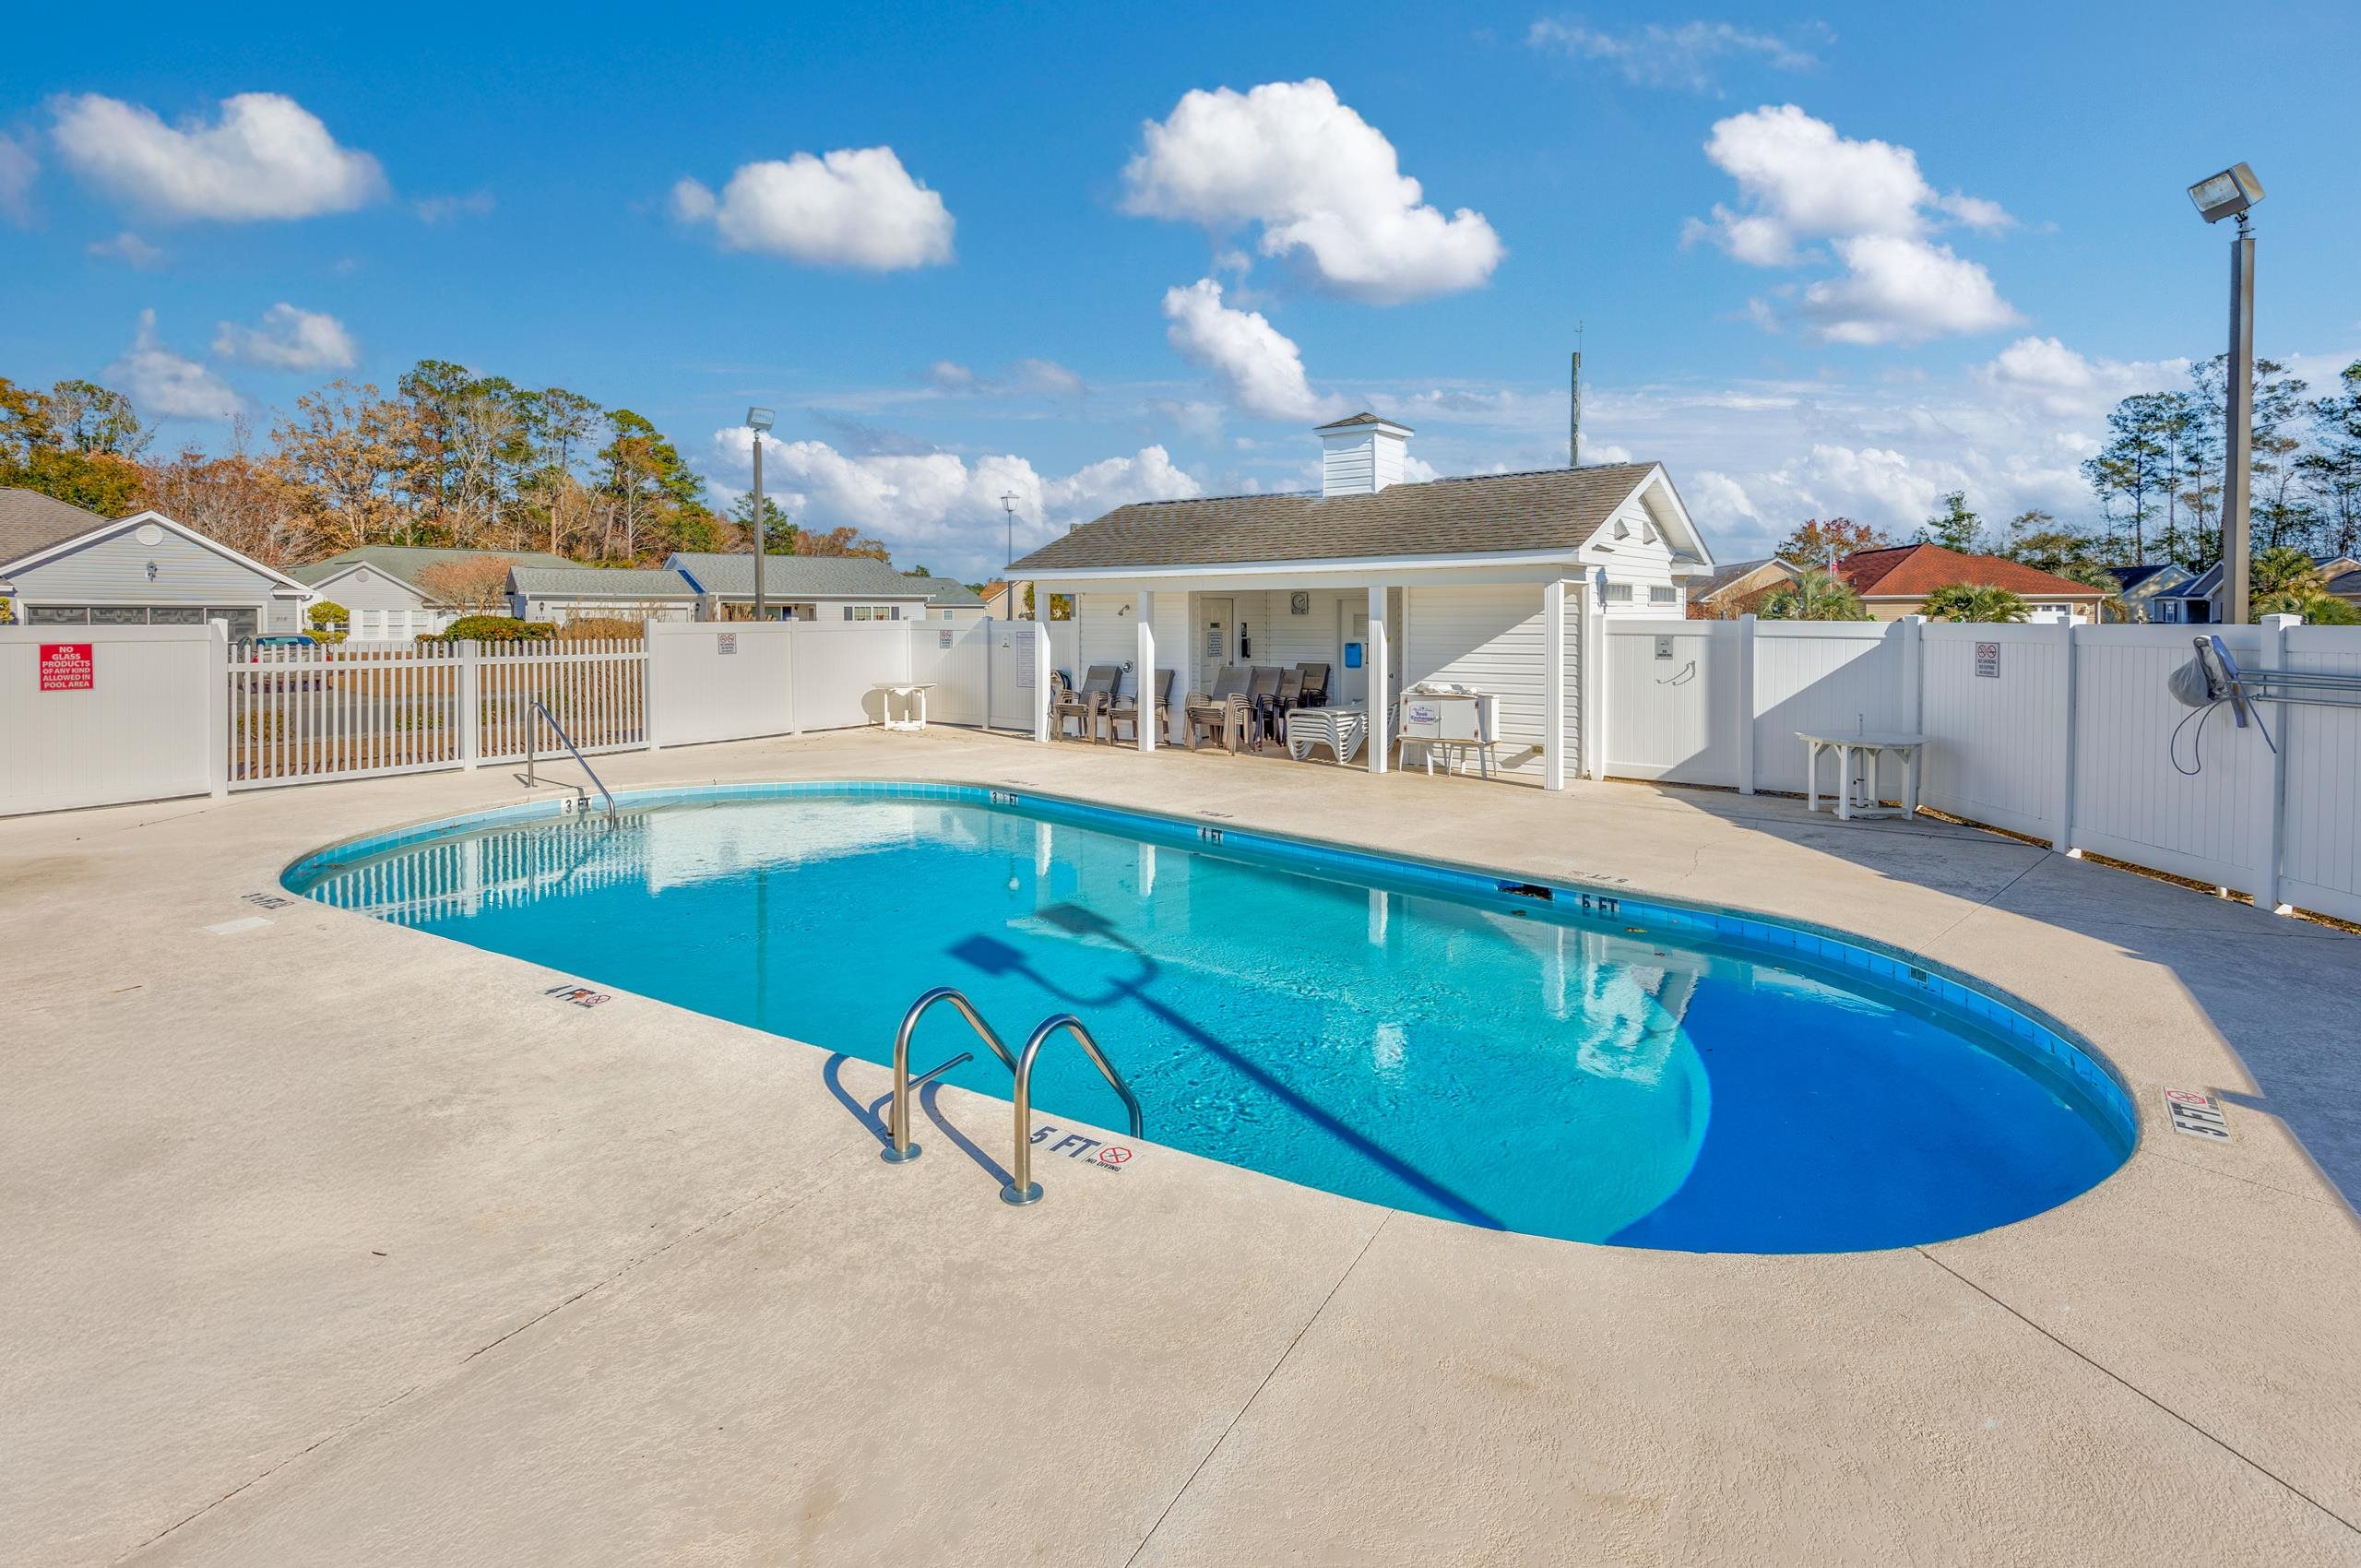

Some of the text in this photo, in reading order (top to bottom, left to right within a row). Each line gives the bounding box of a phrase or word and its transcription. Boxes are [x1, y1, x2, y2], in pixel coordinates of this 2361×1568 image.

[565, 799, 573, 813] 3
[1211, 828, 1223, 840] FT
[1597, 896, 1619, 912] FT
[2174, 1120, 2229, 1137] 5
[1029, 1125, 1102, 1158] 5 FT
[1086, 1157, 1121, 1172] NO DIVING
